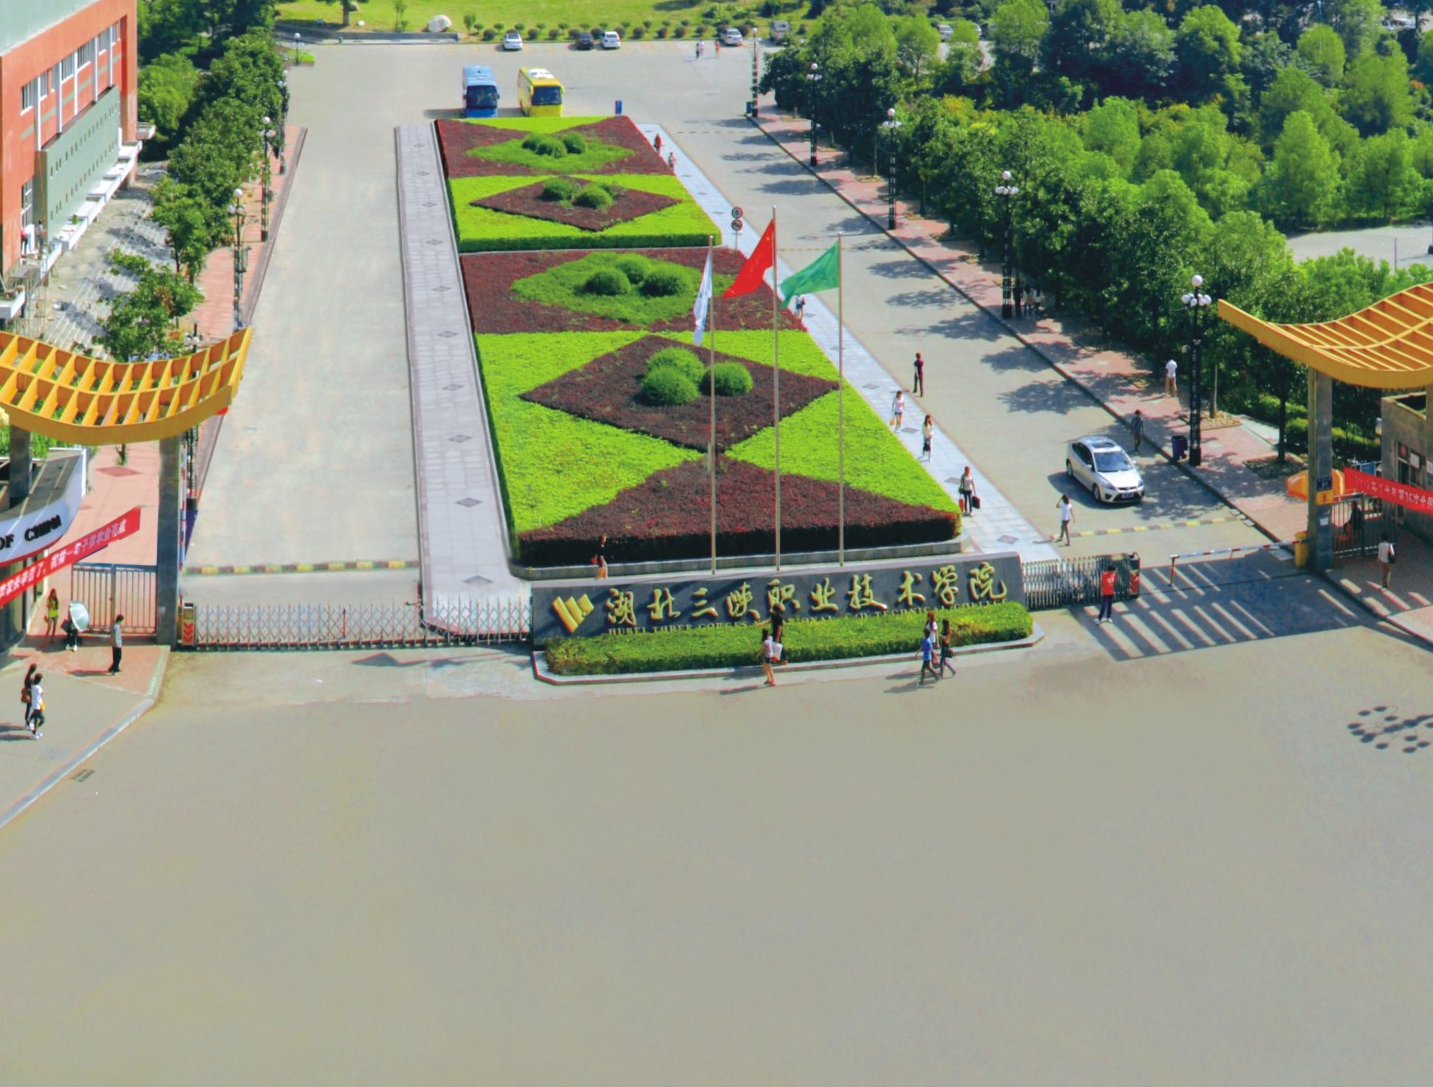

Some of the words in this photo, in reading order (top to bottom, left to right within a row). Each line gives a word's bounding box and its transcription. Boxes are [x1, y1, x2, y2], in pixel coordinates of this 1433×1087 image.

[24, 514, 63, 542] CHINA
[605, 562, 1008, 627] 湖北三峡职业技术学院
